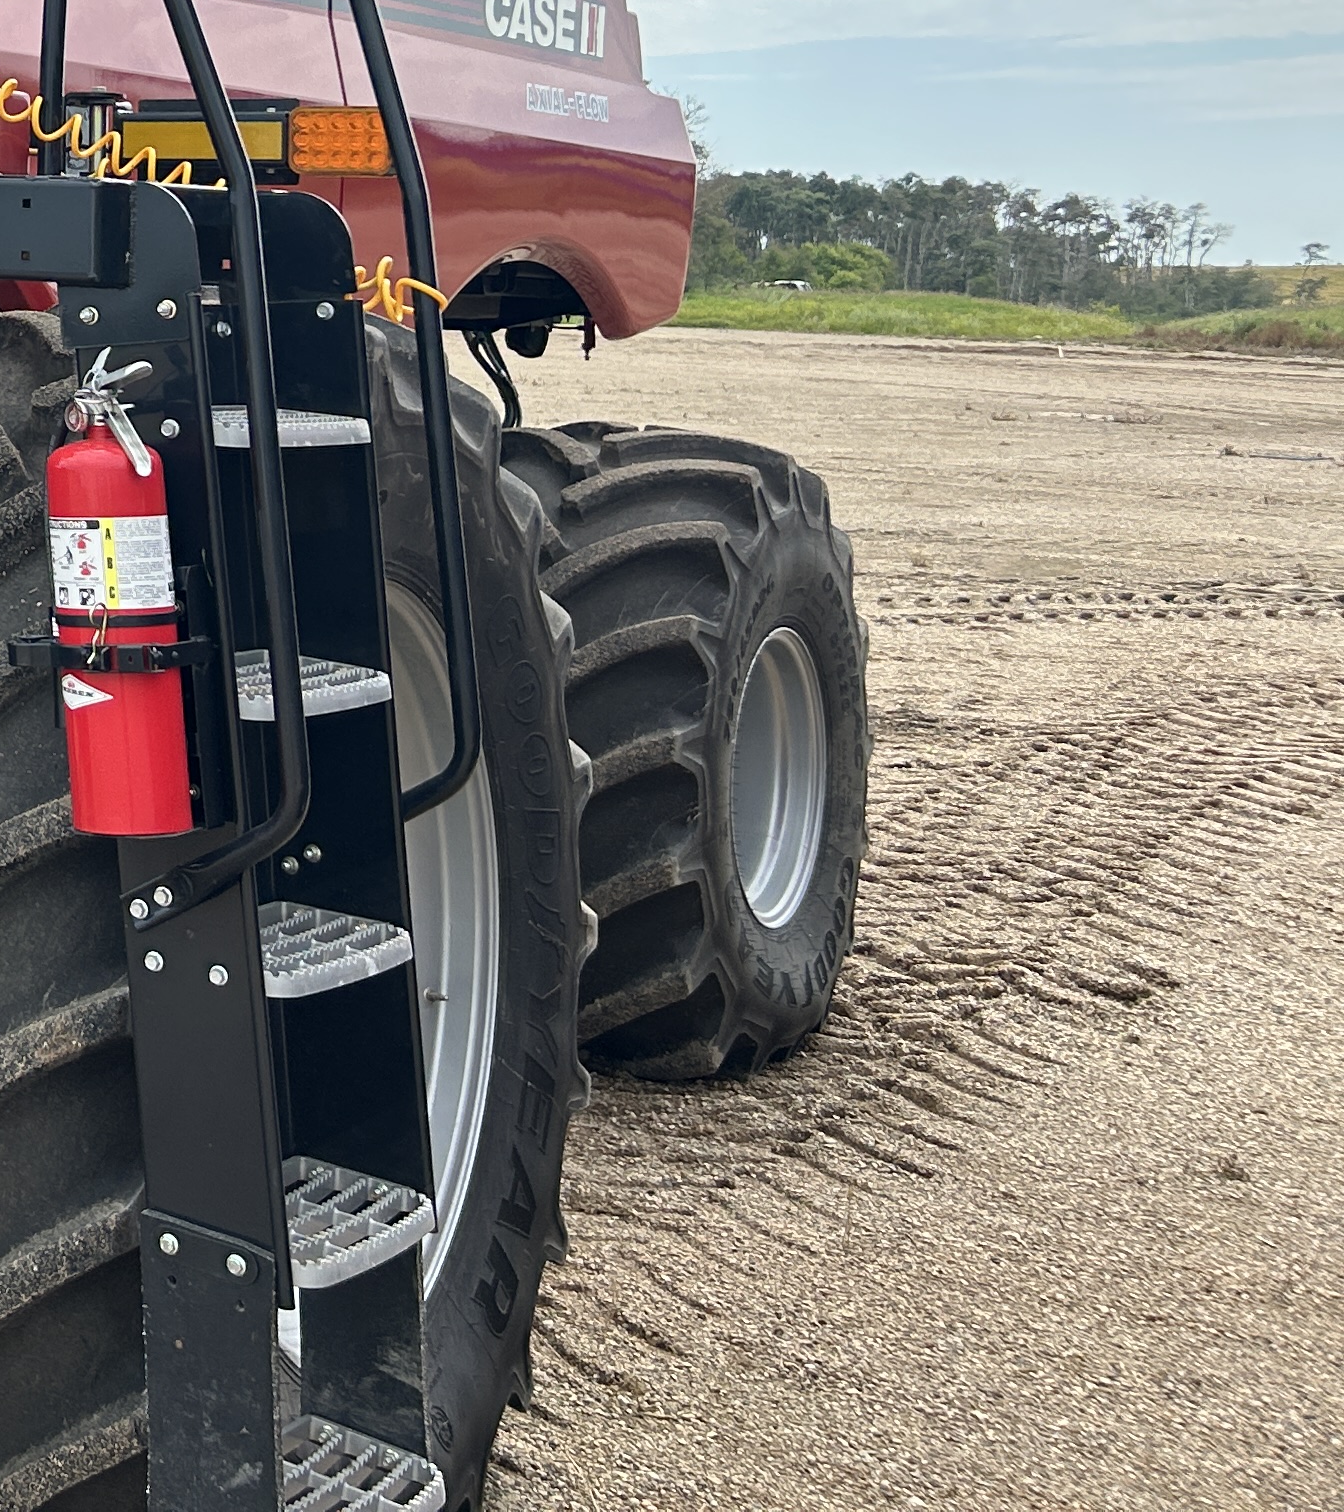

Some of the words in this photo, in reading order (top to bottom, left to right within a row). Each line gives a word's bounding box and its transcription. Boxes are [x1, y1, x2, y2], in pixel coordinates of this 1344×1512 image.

[526, 83, 609, 123] AXIAL-FLOW
[105, 528, 112, 540] A
[106, 557, 113, 569] B
[109, 586, 116, 599] C
[470, 592, 568, 1338] GOODYEAR
